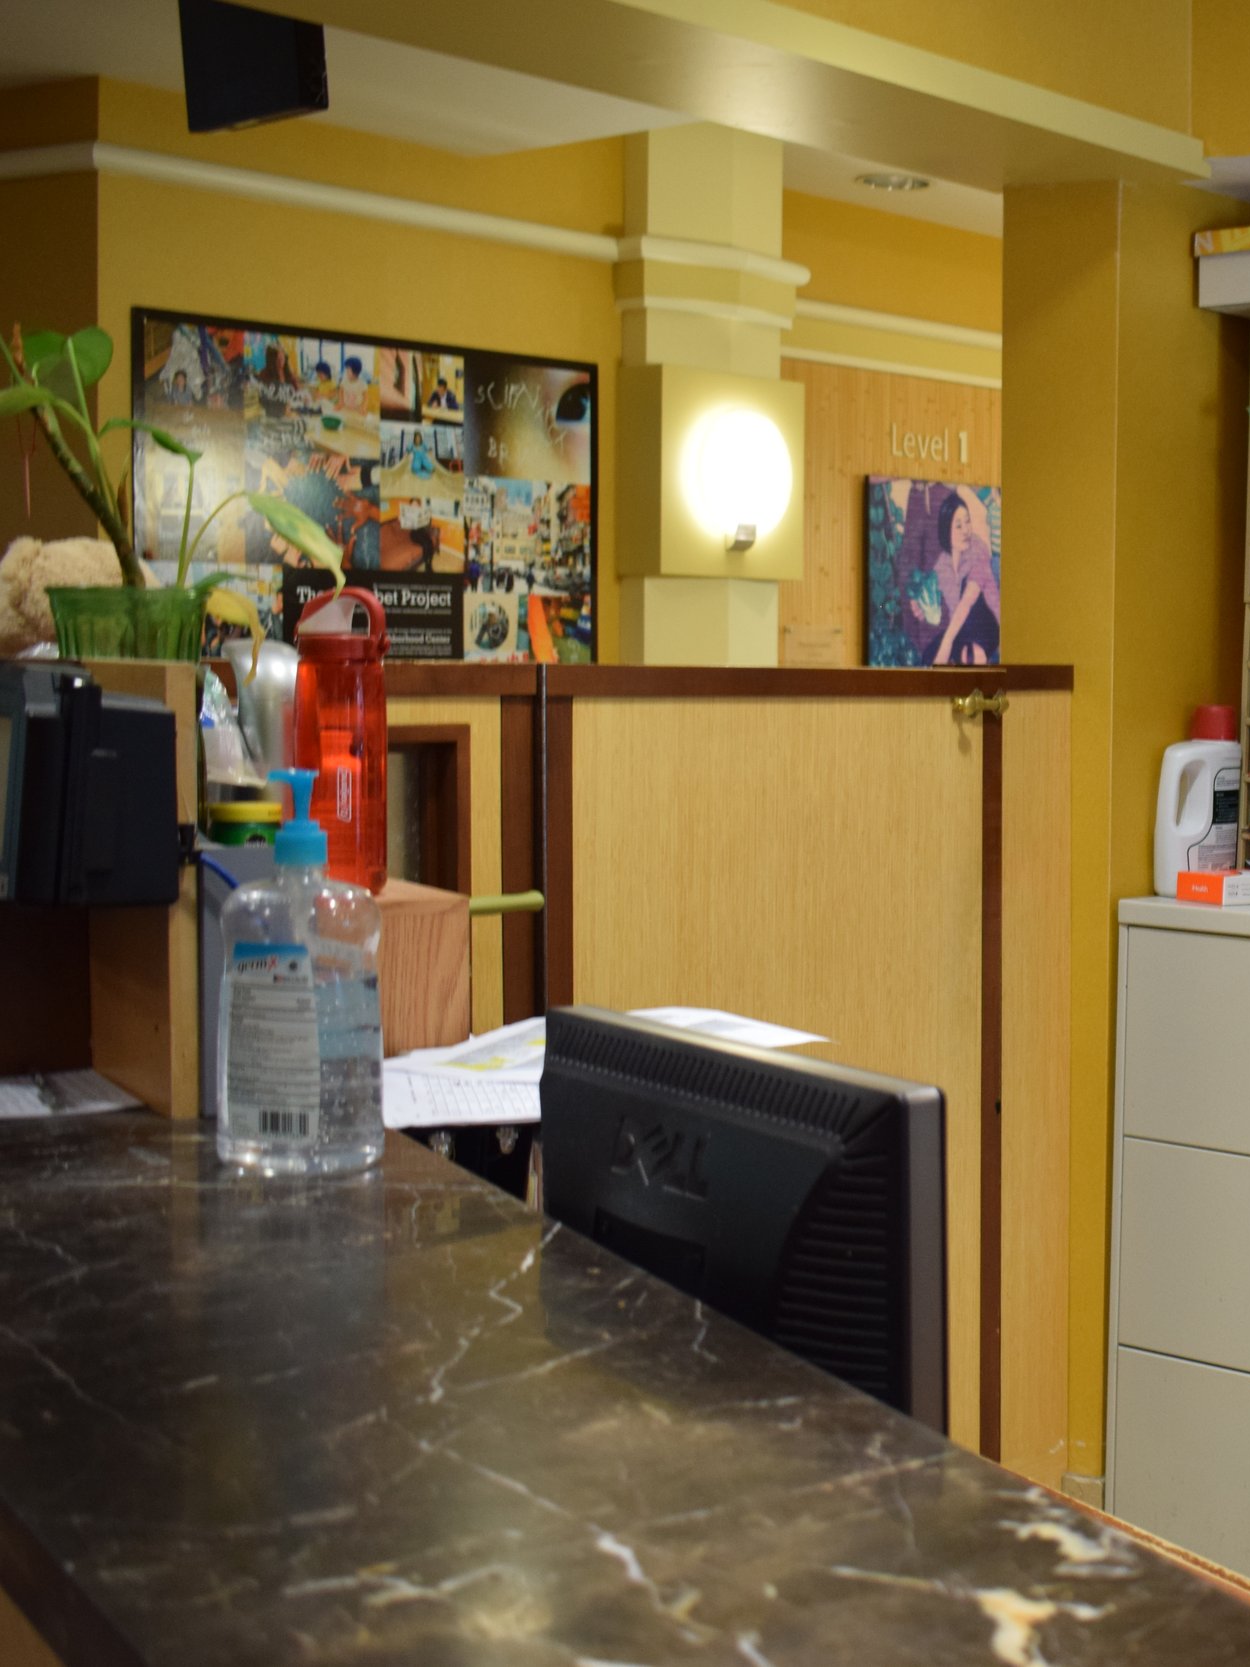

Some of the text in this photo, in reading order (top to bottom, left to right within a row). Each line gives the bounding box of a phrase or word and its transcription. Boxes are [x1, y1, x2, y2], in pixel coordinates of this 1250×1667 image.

[891, 423, 968, 464] Level 1
[401, 588, 451, 610] Project
